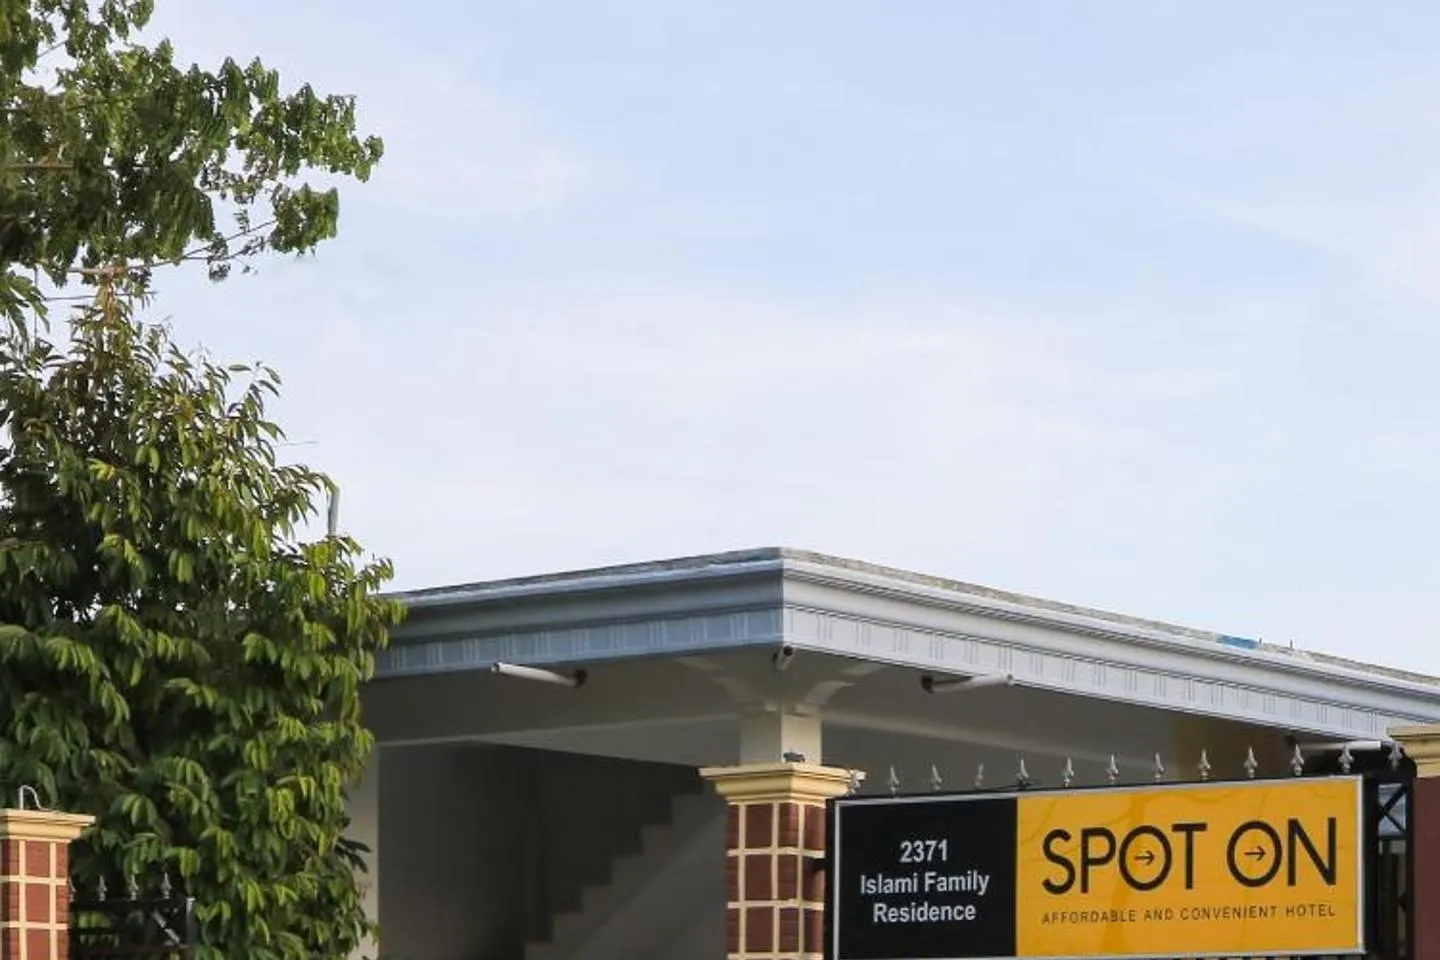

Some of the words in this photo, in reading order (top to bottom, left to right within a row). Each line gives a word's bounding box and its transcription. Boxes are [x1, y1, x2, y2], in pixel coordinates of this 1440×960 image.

[899, 838, 948, 864] 2371
[1042, 822, 1208, 896] SPOT
[1226, 817, 1337, 889] ON
[860, 872, 918, 895] Islami
[924, 870, 990, 897] Family
[872, 902, 977, 925] Residence
[1042, 909, 1136, 925] AFFORDABLE
[1143, 908, 1174, 922] AND
[1179, 905, 1277, 920] CONVENIENT
[1285, 903, 1337, 917] HOTEL
